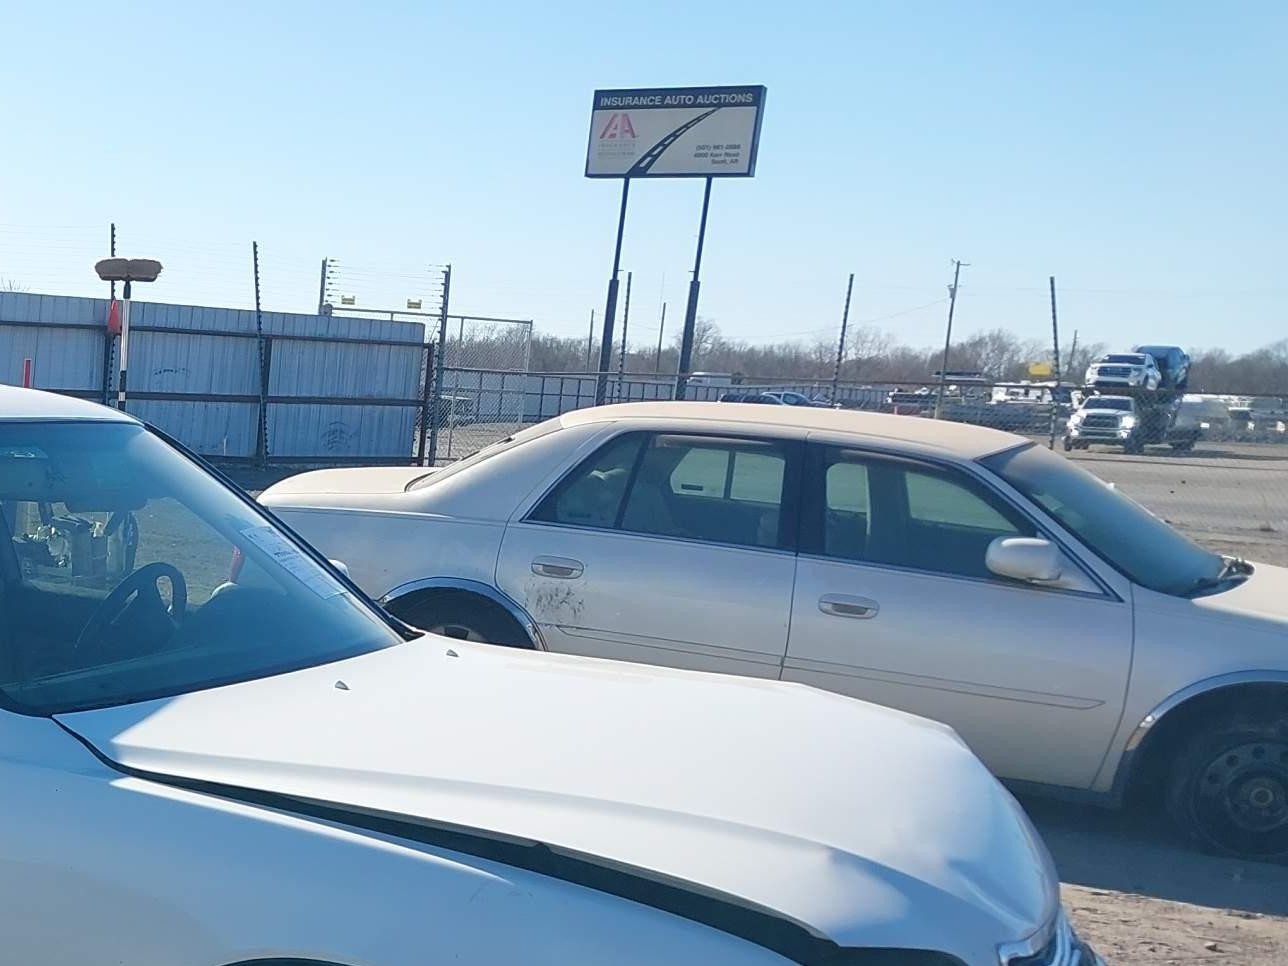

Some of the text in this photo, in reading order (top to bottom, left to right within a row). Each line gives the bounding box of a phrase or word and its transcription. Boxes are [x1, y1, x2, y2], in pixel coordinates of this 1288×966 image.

[600, 93, 753, 107] INSURANCE AUTO AUCTIONS
